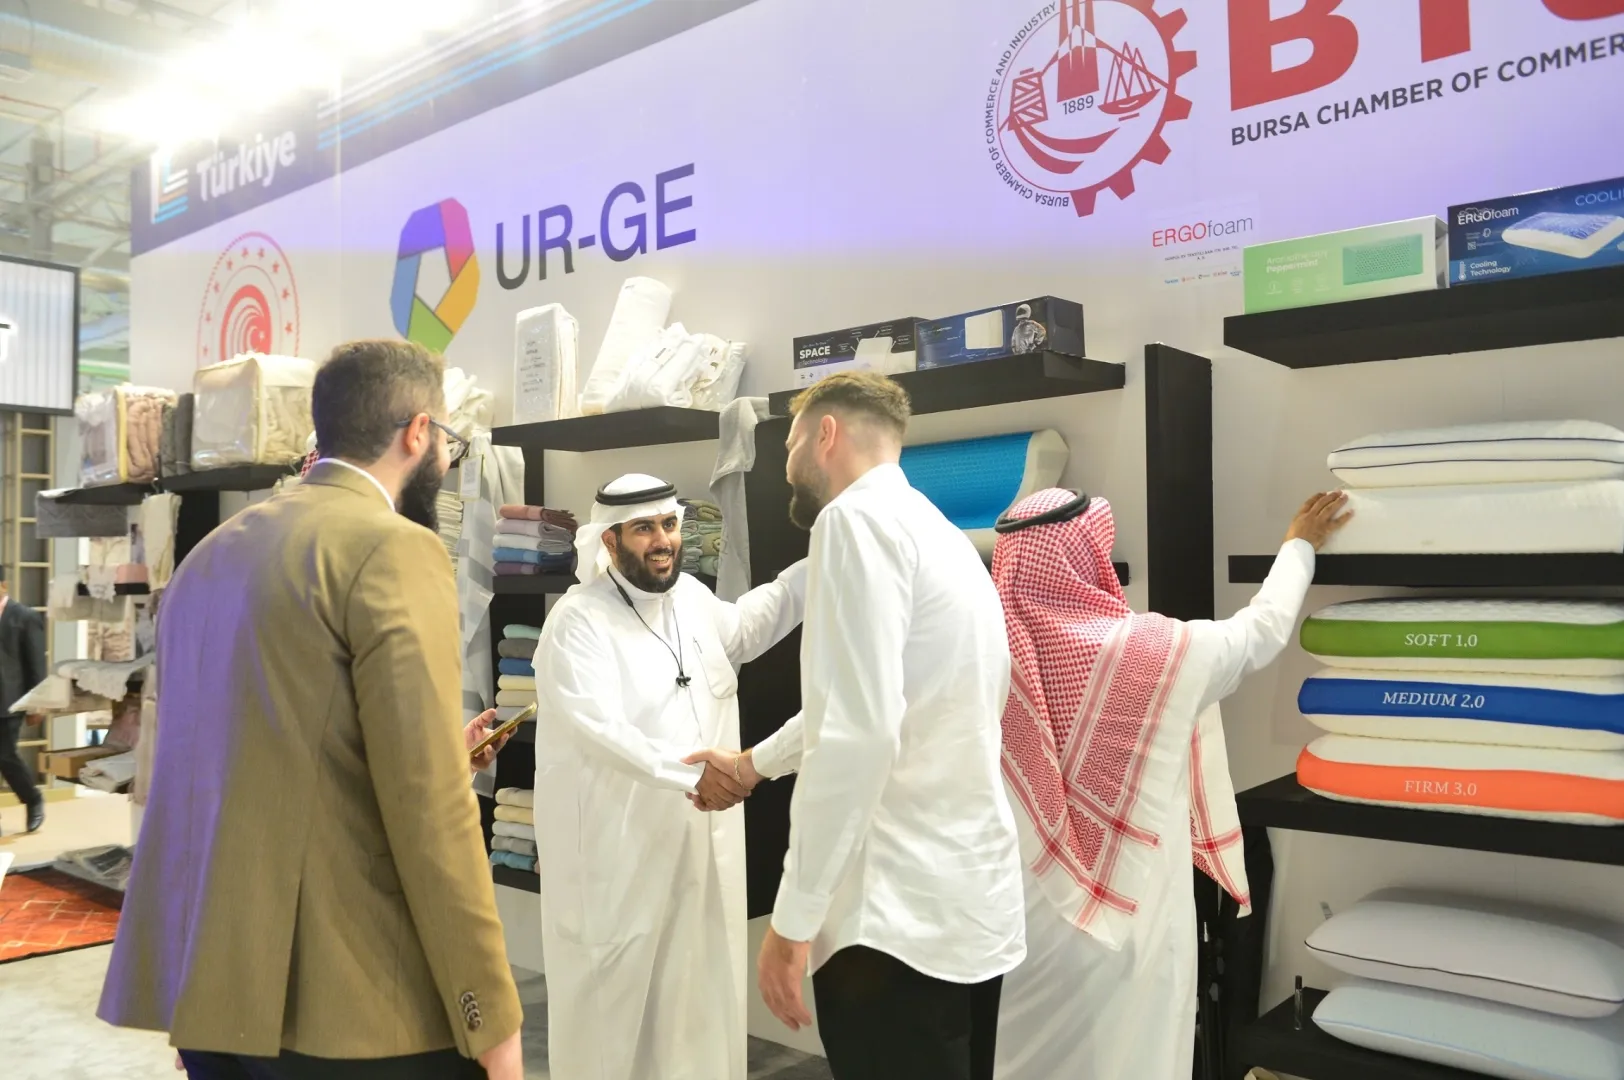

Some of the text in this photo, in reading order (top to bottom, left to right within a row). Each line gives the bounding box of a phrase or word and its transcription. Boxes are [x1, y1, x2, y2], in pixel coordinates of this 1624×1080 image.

[1231, 33, 1624, 146] BURSA CHAMBER OF COMMER
[985, 1, 1070, 207] BURSA CHAMBER OF COMMERCE AND INDUSTRY
[1062, 95, 1094, 115] 1889
[196, 130, 296, 201] Türkiye
[1575, 187, 1624, 207] COOLI
[496, 162, 696, 290] UR-GE
[1457, 207, 1519, 226] ERGOfoam
[1152, 217, 1253, 248] ERGOfoam
[1470, 260, 1498, 269] Cooling
[1470, 266, 1512, 277] Technology
[799, 345, 831, 360] SPACE
[1404, 633, 1478, 648] SOFT 1.0
[1382, 691, 1485, 709] MEDIUM 2.0
[1404, 780, 1477, 796] FIRM 3.0
